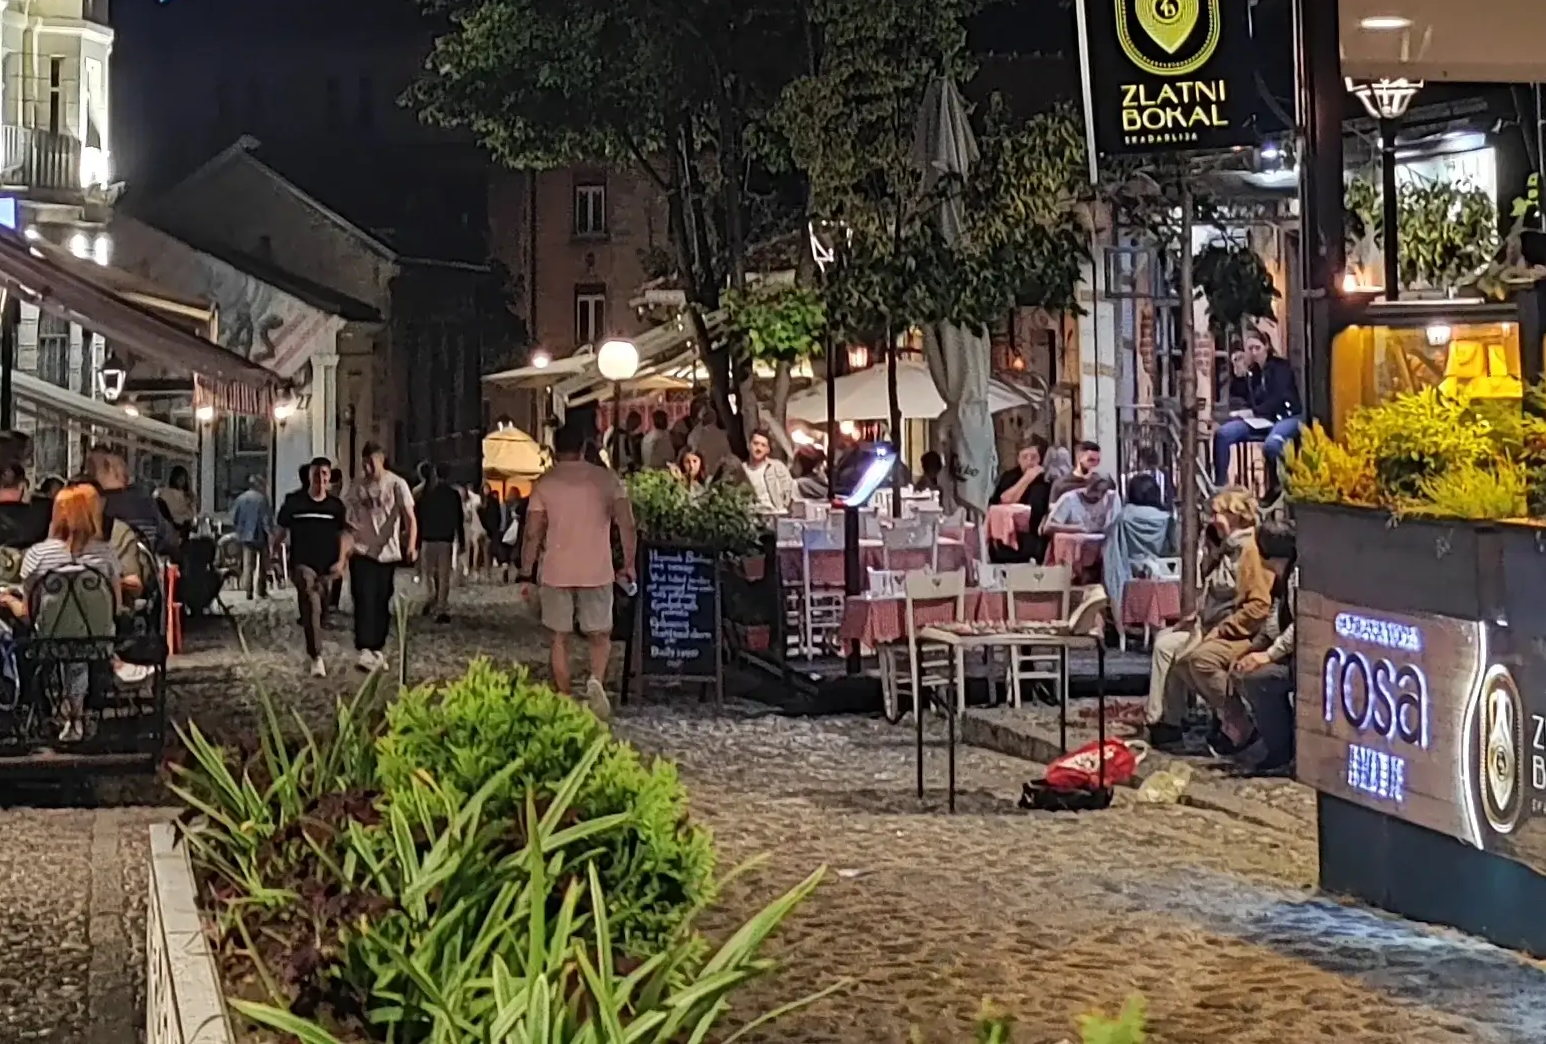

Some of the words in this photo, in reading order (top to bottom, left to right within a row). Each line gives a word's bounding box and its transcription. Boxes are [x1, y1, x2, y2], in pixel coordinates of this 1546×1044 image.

[1120, 79, 1226, 107] ZLATNI
[1122, 103, 1229, 131] BOKAL
[1323, 646, 1428, 750] rosa
